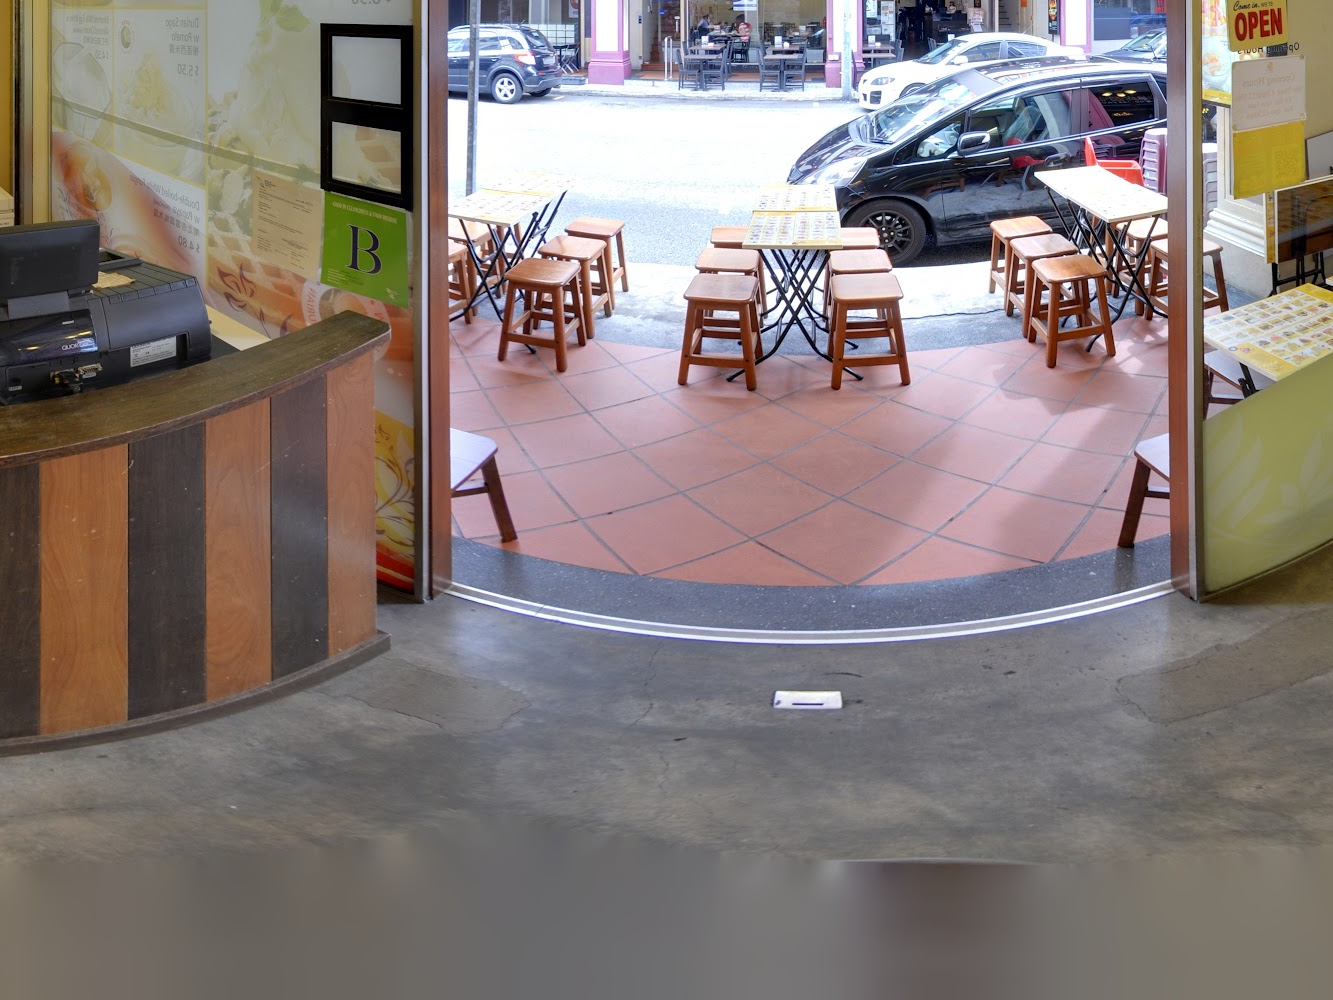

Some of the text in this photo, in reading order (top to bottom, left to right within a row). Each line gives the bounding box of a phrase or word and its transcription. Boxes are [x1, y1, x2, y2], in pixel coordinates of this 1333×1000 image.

[1233, 1, 1251, 12] Come
[1234, 7, 1283, 42] OPEN
[346, 224, 382, 275] B
